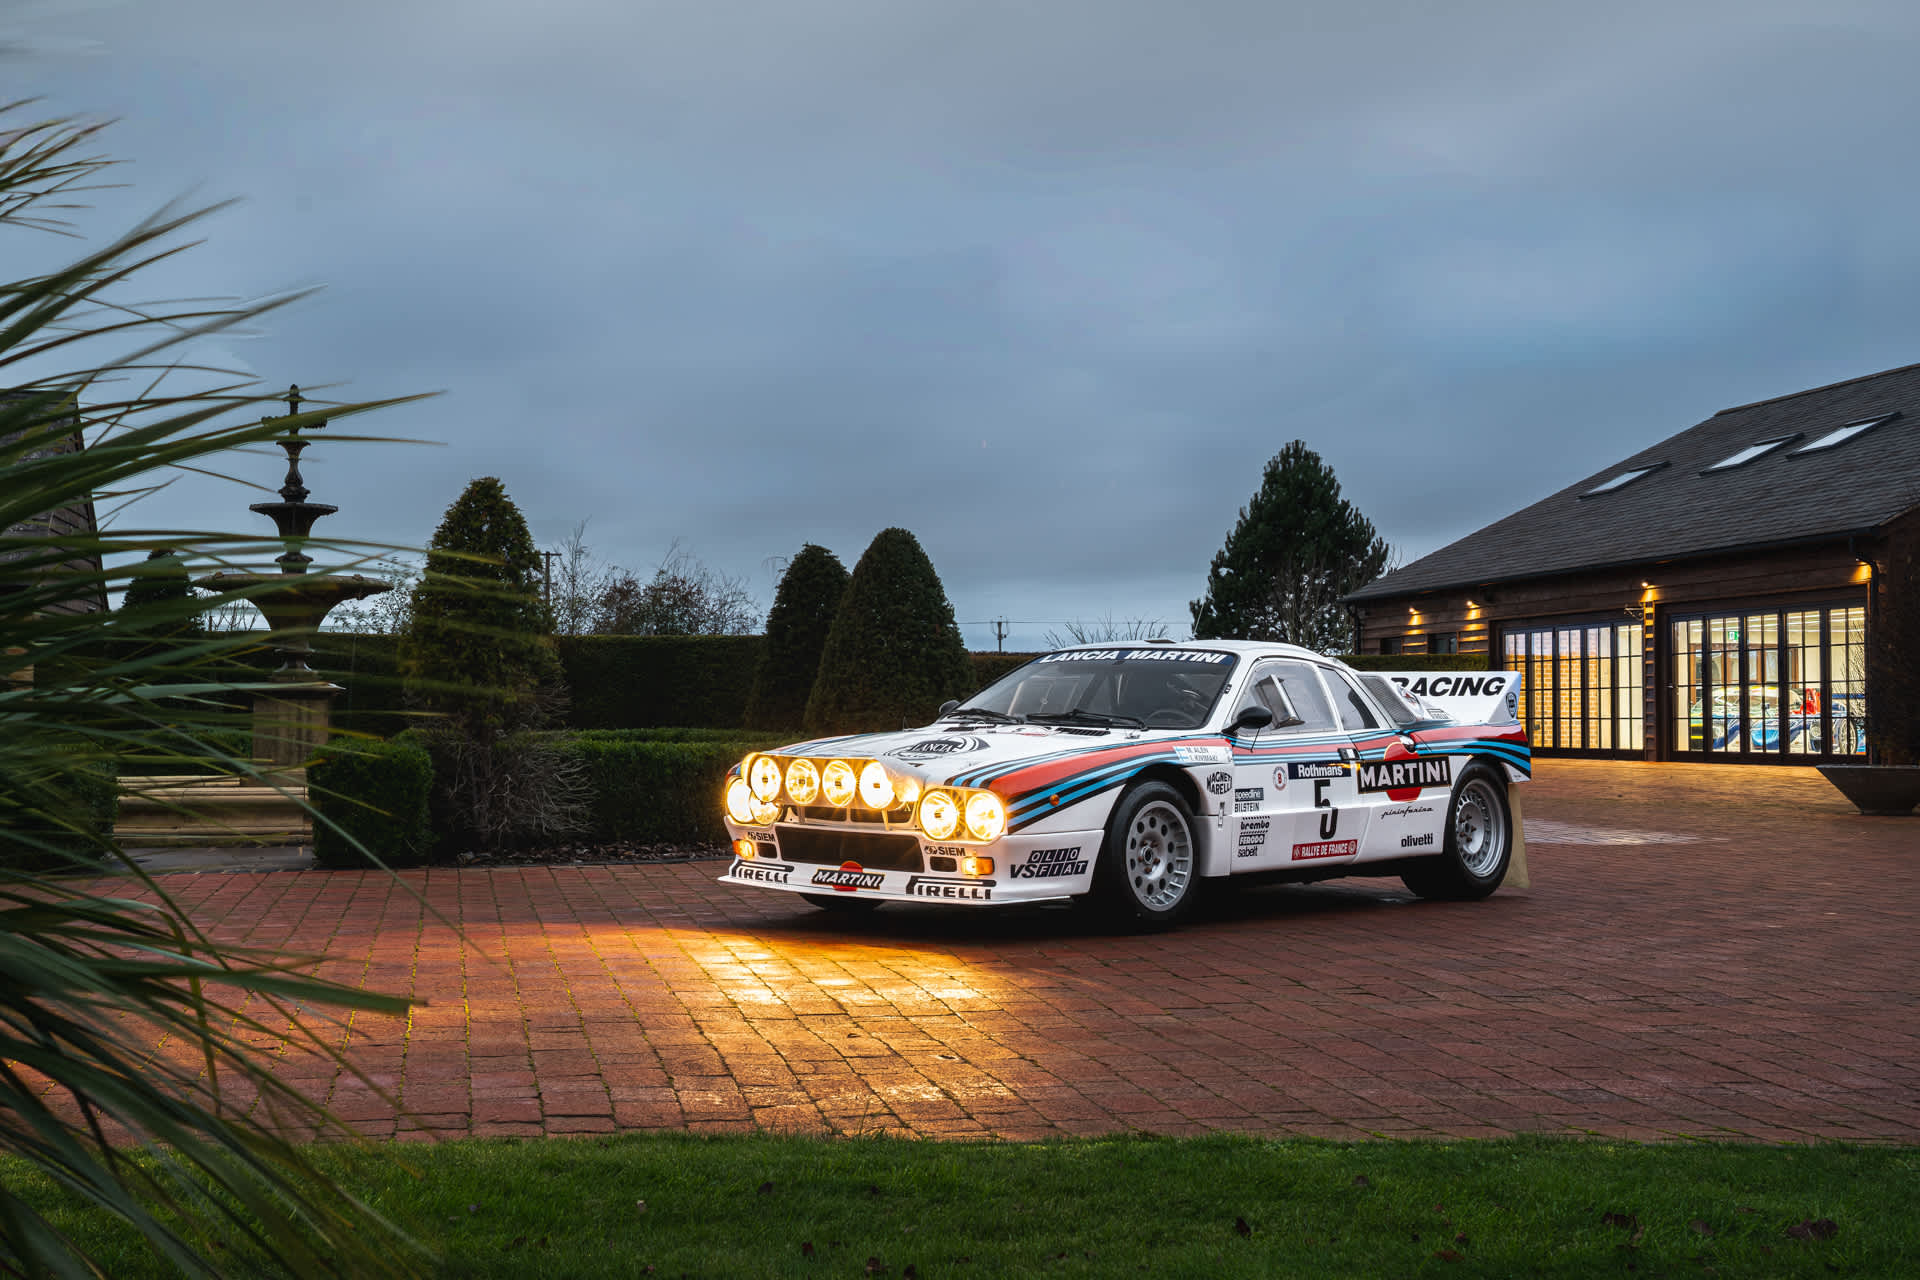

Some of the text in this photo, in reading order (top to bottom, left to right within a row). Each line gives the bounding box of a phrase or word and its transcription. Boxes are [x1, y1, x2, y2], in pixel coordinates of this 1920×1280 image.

[1040, 650, 1227, 664] LANCIA MARTINI
[911, 743, 957, 753] LANCIA
[1297, 764, 1343, 777] Rothmans
[1360, 760, 1448, 788] MARTINI
[1234, 802, 1260, 813] BILSTEIN
[1314, 779, 1338, 840] 5
[1240, 820, 1270, 830] brembo
[756, 831, 776, 842] SIEM
[1240, 835, 1265, 845] FERODO
[1401, 833, 1434, 847] olivetti
[937, 846, 966, 857] SIEM
[1028, 847, 1081, 863] OLIO
[1237, 846, 1258, 857] sabelt
[1301, 843, 1348, 857] RALLYE DE FRANCE
[731, 859, 795, 884] PIRELLI
[814, 871, 884, 887] MARTINI
[906, 875, 997, 900] PIRELLI
